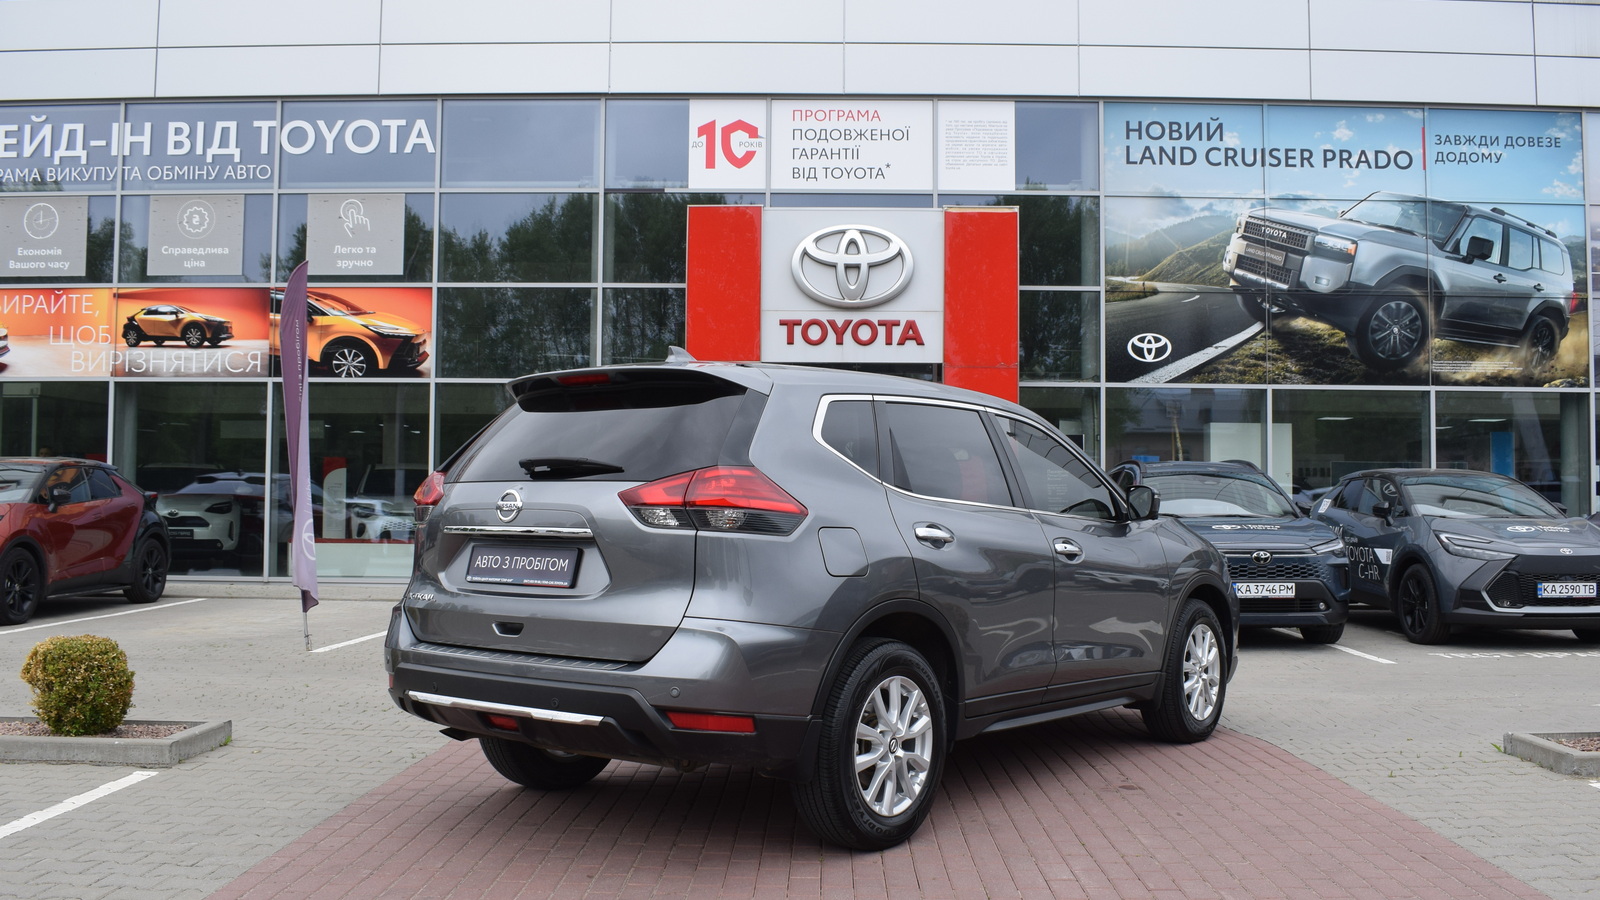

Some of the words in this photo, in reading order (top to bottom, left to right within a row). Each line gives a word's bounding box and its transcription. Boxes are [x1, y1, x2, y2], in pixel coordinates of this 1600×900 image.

[792, 109, 882, 122] ПРОГРАМА
[792, 125, 911, 144] ПОДОВЖЕНОЇ
[1125, 116, 1224, 142] НОВИЙ
[167, 120, 241, 163] ВІД
[253, 119, 436, 155] TOYOTA
[691, 141, 704, 149] ДО
[697, 118, 759, 170] 10
[1434, 134, 1500, 149] ЗАВЖДИ
[1504, 136, 1562, 150] ДОВЕЗЕ
[792, 144, 861, 160] ГАРАНТІЇ
[1125, 145, 1198, 166] LAND
[1205, 146, 1315, 168] CRUISER
[1322, 148, 1413, 170] PRADO
[1434, 151, 1503, 165] ДОДОМУ
[46, 166, 118, 182] ВИКУПУ
[123, 165, 142, 181] ТА
[147, 164, 220, 181] ОБМІНУ
[223, 164, 272, 180] АВТО
[792, 166, 818, 182] ВІД
[1260, 226, 1287, 239] TOYOTA
[17, 246, 62, 256] Економія
[161, 245, 230, 256] Справедлива
[333, 245, 364, 254] Легко
[365, 246, 377, 254] та
[9, 260, 46, 269] Вашого
[47, 261, 70, 270] часу
[183, 258, 206, 269] ціна
[336, 260, 374, 269] зручно
[0, 290, 99, 317] ИРАЙТЕ,
[49, 325, 111, 349] ЩОБ
[779, 318, 925, 346] TOYOTA
[70, 350, 262, 373] ВИРІЗНЯТИСЯ
[1345, 545, 1375, 563] TOYOTA
[474, 555, 501, 569] АВТО
[502, 556, 511, 569] З
[511, 556, 569, 572] ПРОБІГОМ
[1358, 563, 1381, 580] C-HR
[1237, 584, 1252, 595] KA
[1253, 584, 1277, 595] 3746
[1278, 584, 1294, 595] PM
[1542, 584, 1557, 595] KA
[1558, 584, 1581, 595] 2590
[1582, 584, 1596, 595] TB
